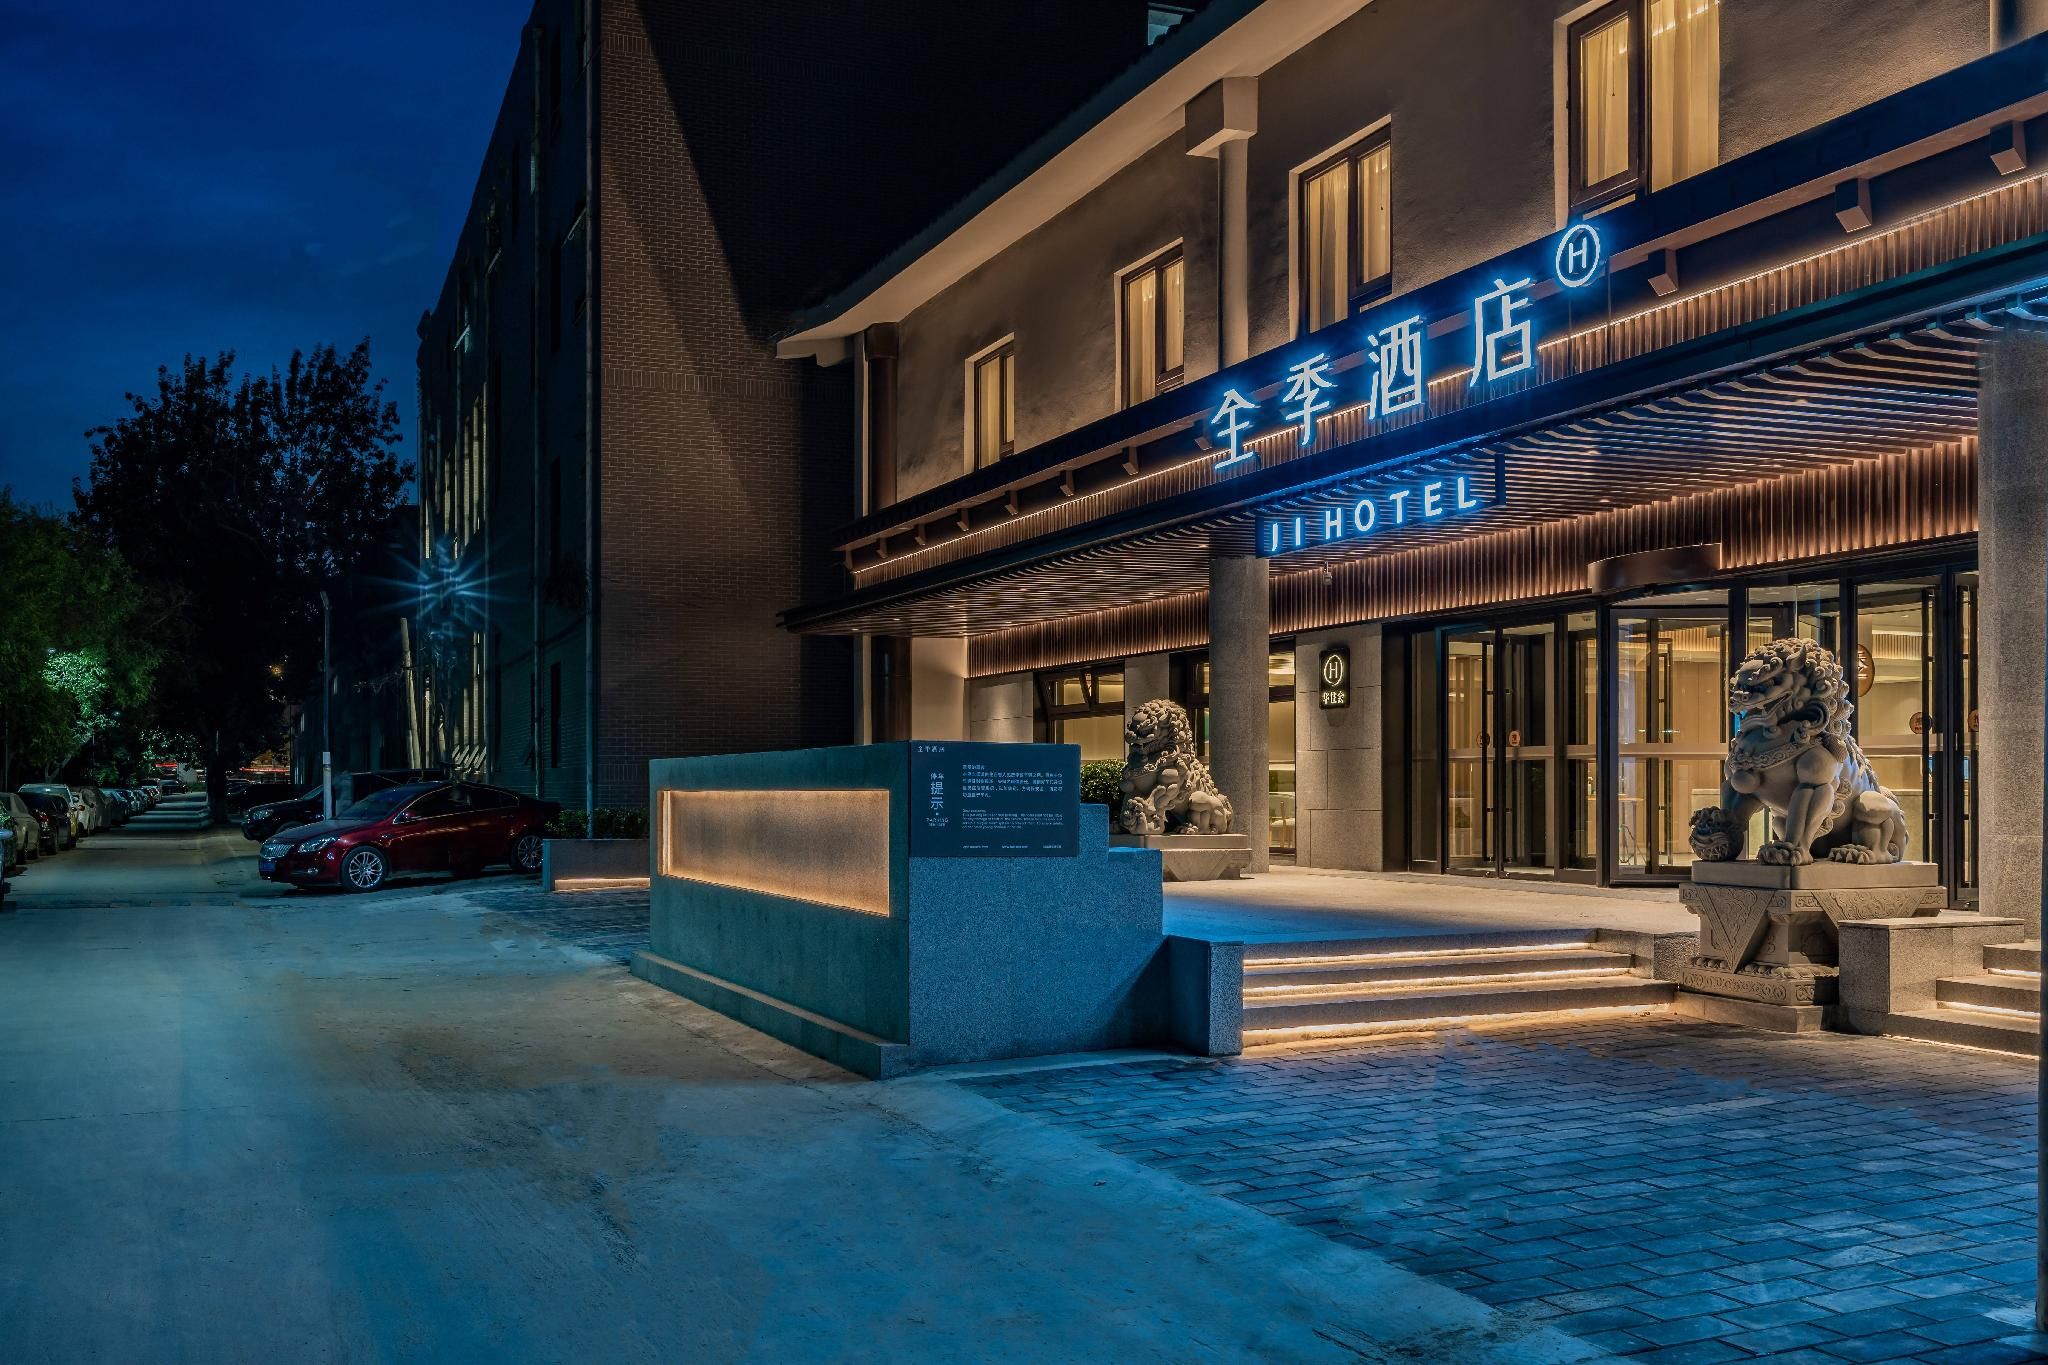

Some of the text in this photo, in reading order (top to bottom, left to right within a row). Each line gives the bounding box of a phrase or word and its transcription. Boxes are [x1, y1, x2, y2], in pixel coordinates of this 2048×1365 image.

[1211, 277, 1533, 471] 全季酒店
[1271, 476, 1478, 552] JI HOTEL
[930, 781, 944, 810] 提示
